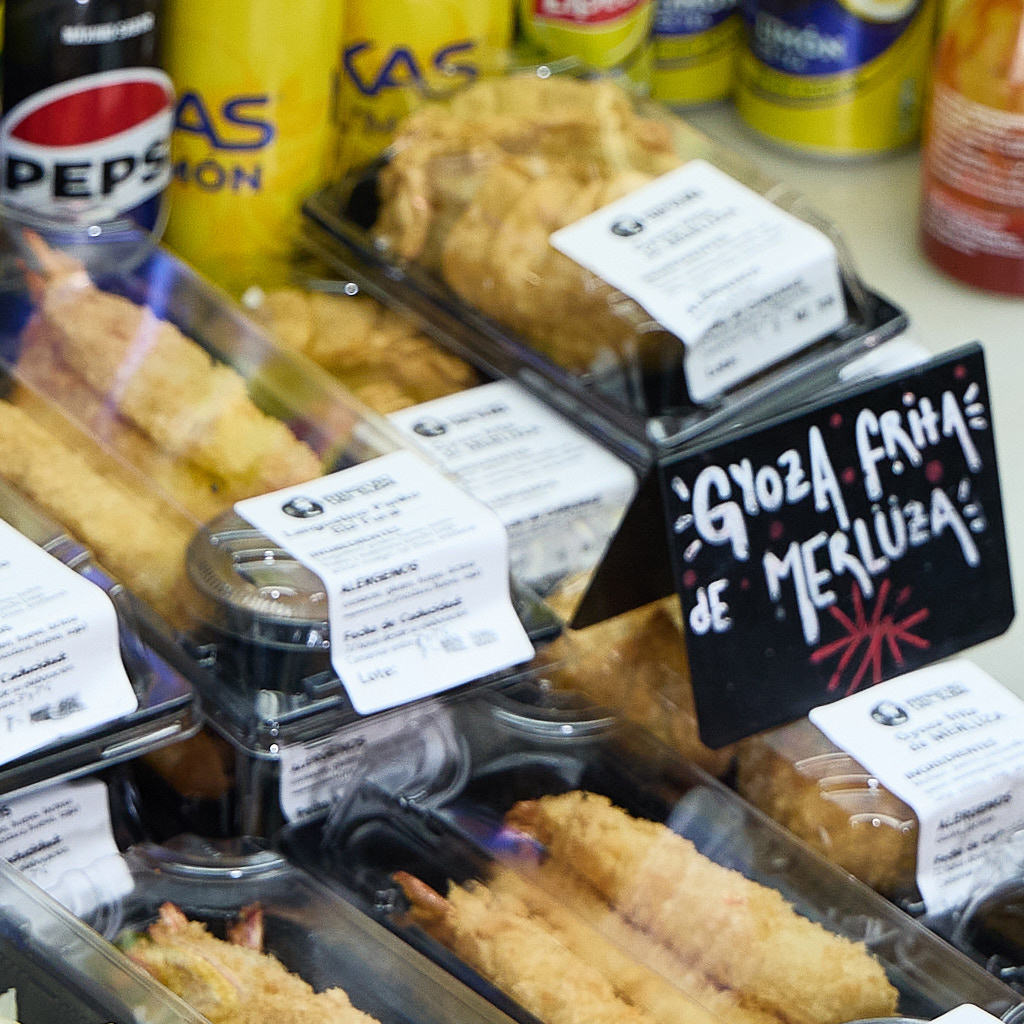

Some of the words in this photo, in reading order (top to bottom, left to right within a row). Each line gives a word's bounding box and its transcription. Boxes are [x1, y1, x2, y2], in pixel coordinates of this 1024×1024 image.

[174, 90, 276, 152] AS
[6, 142, 168, 198] PEPS
[692, 424, 851, 562] GYOZA
